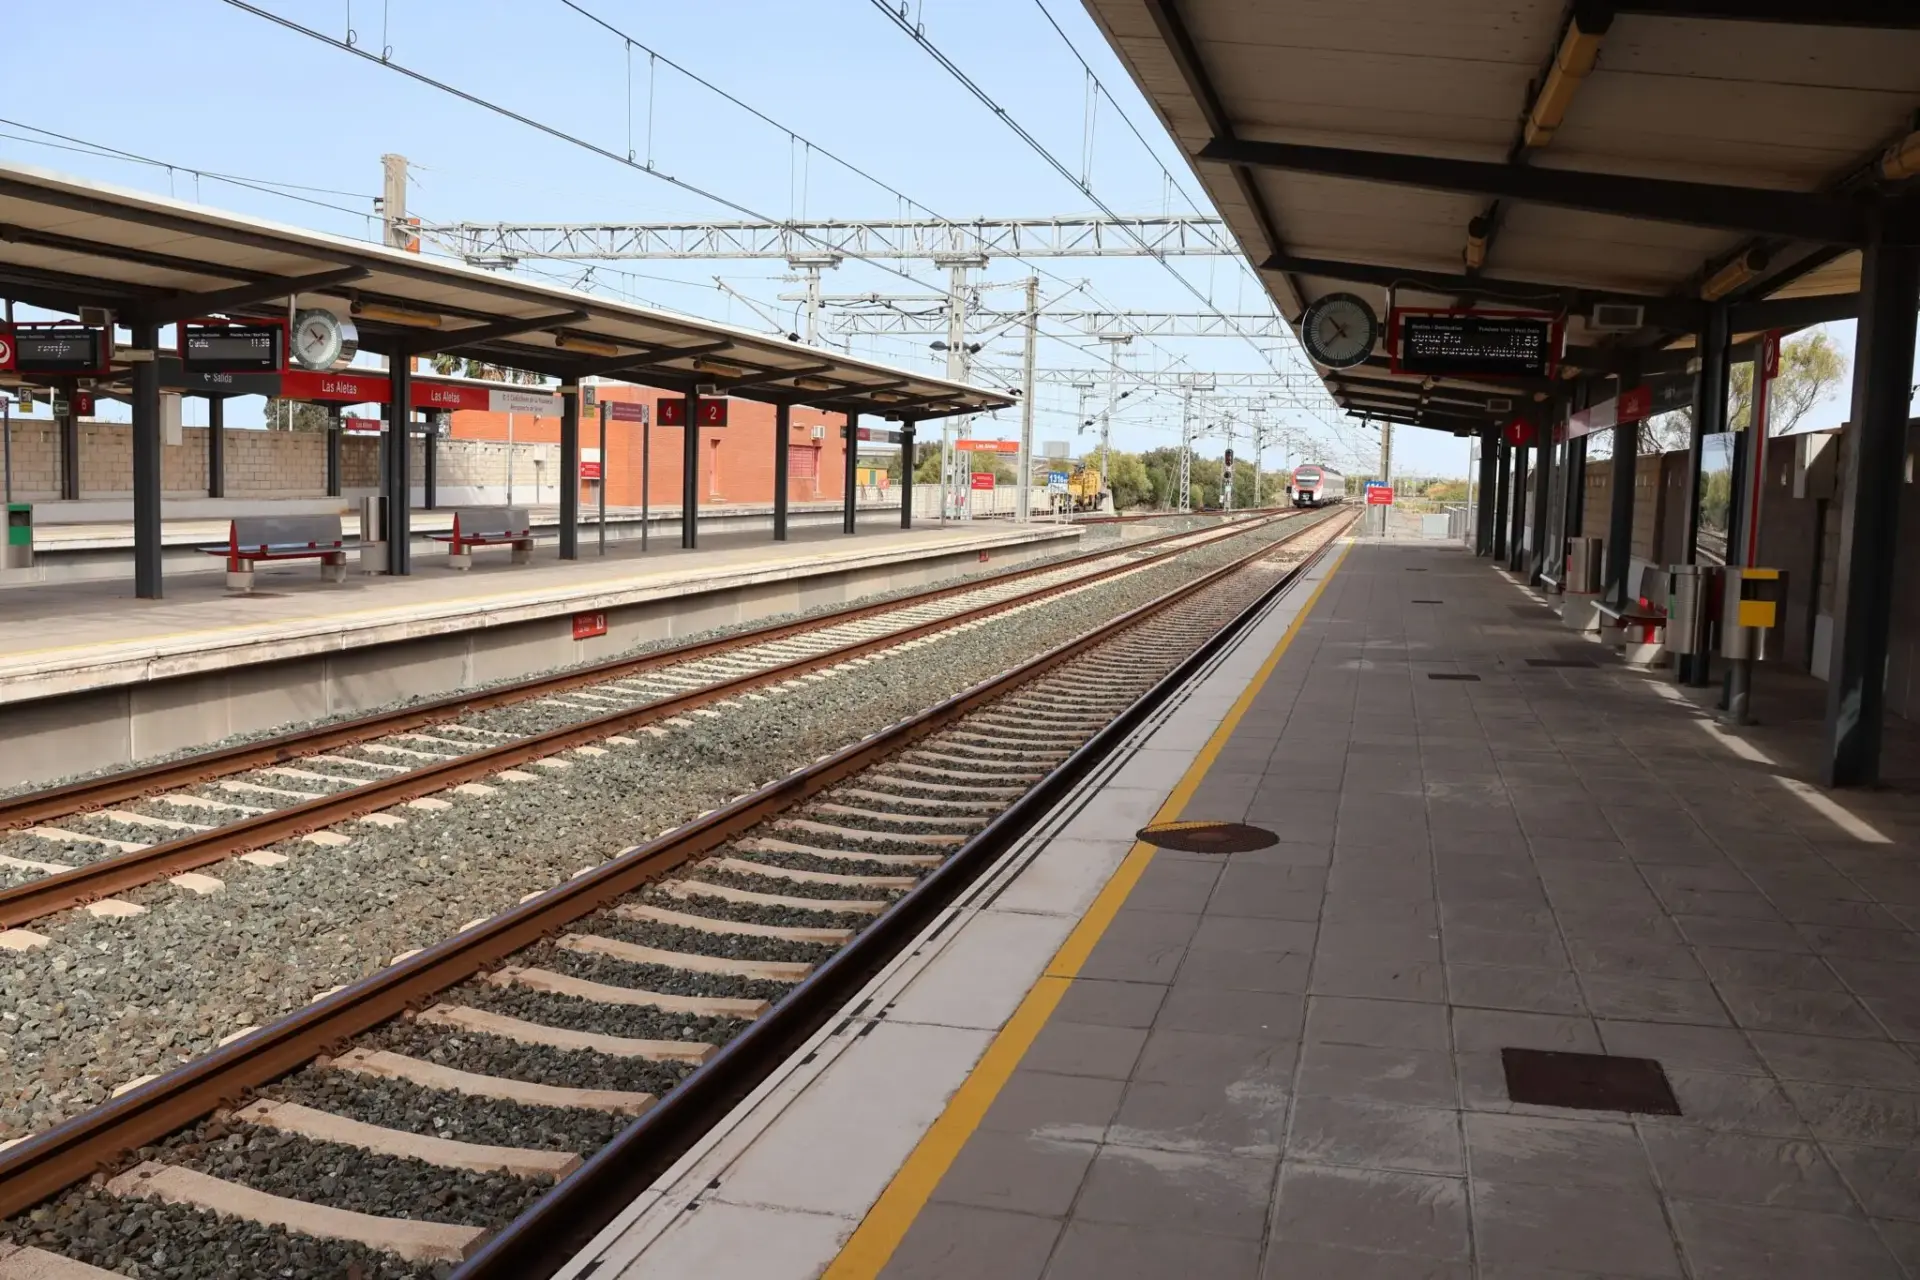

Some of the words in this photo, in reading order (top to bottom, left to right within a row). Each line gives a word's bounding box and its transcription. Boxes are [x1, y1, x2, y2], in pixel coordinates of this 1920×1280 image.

[213, 372, 232, 383] Salida
[322, 380, 335, 393] Las
[336, 381, 357, 395] Aletas
[431, 390, 442, 401] Las
[443, 391, 460, 403] Aletas
[665, 406, 672, 419] 4
[710, 406, 717, 420] 2
[1515, 424, 1520, 439] 1
